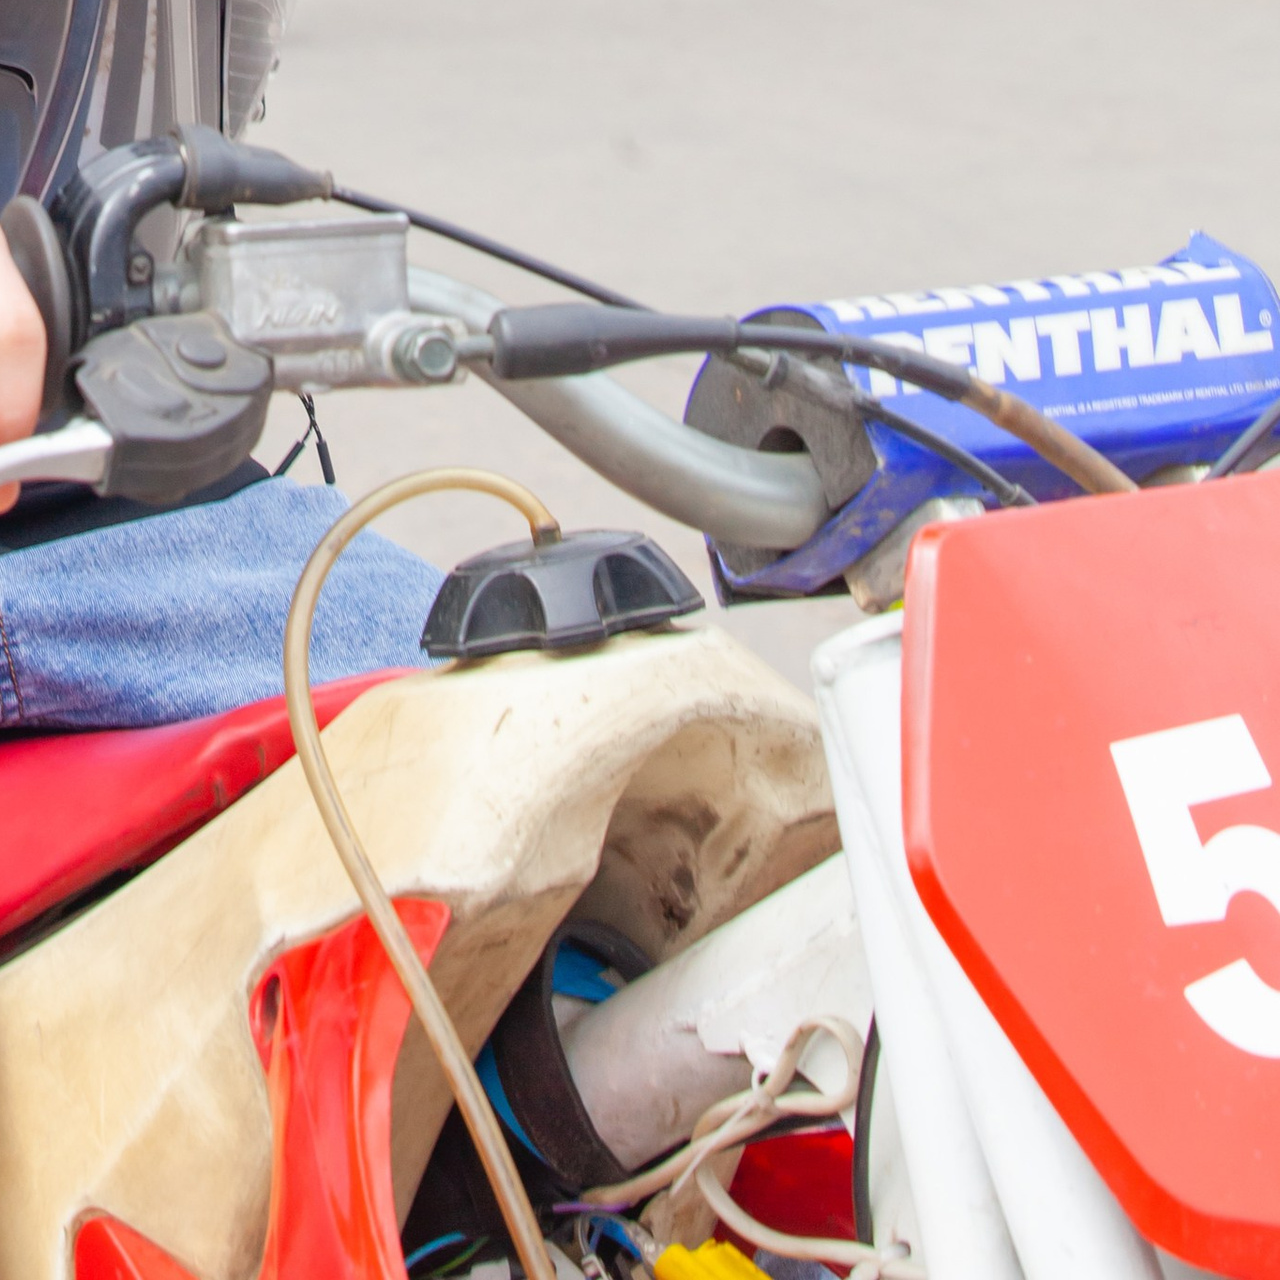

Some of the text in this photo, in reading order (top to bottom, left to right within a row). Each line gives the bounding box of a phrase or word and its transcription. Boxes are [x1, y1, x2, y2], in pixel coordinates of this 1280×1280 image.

[870, 294, 1274, 397] RENTHAL
[1092, 396, 1138, 412] REGISTERED
[1137, 389, 1183, 407] TRADEMARK
[1183, 388, 1194, 403] OF
[1194, 384, 1228, 401] RENTHAL
[1109, 713, 1280, 1060] 5
